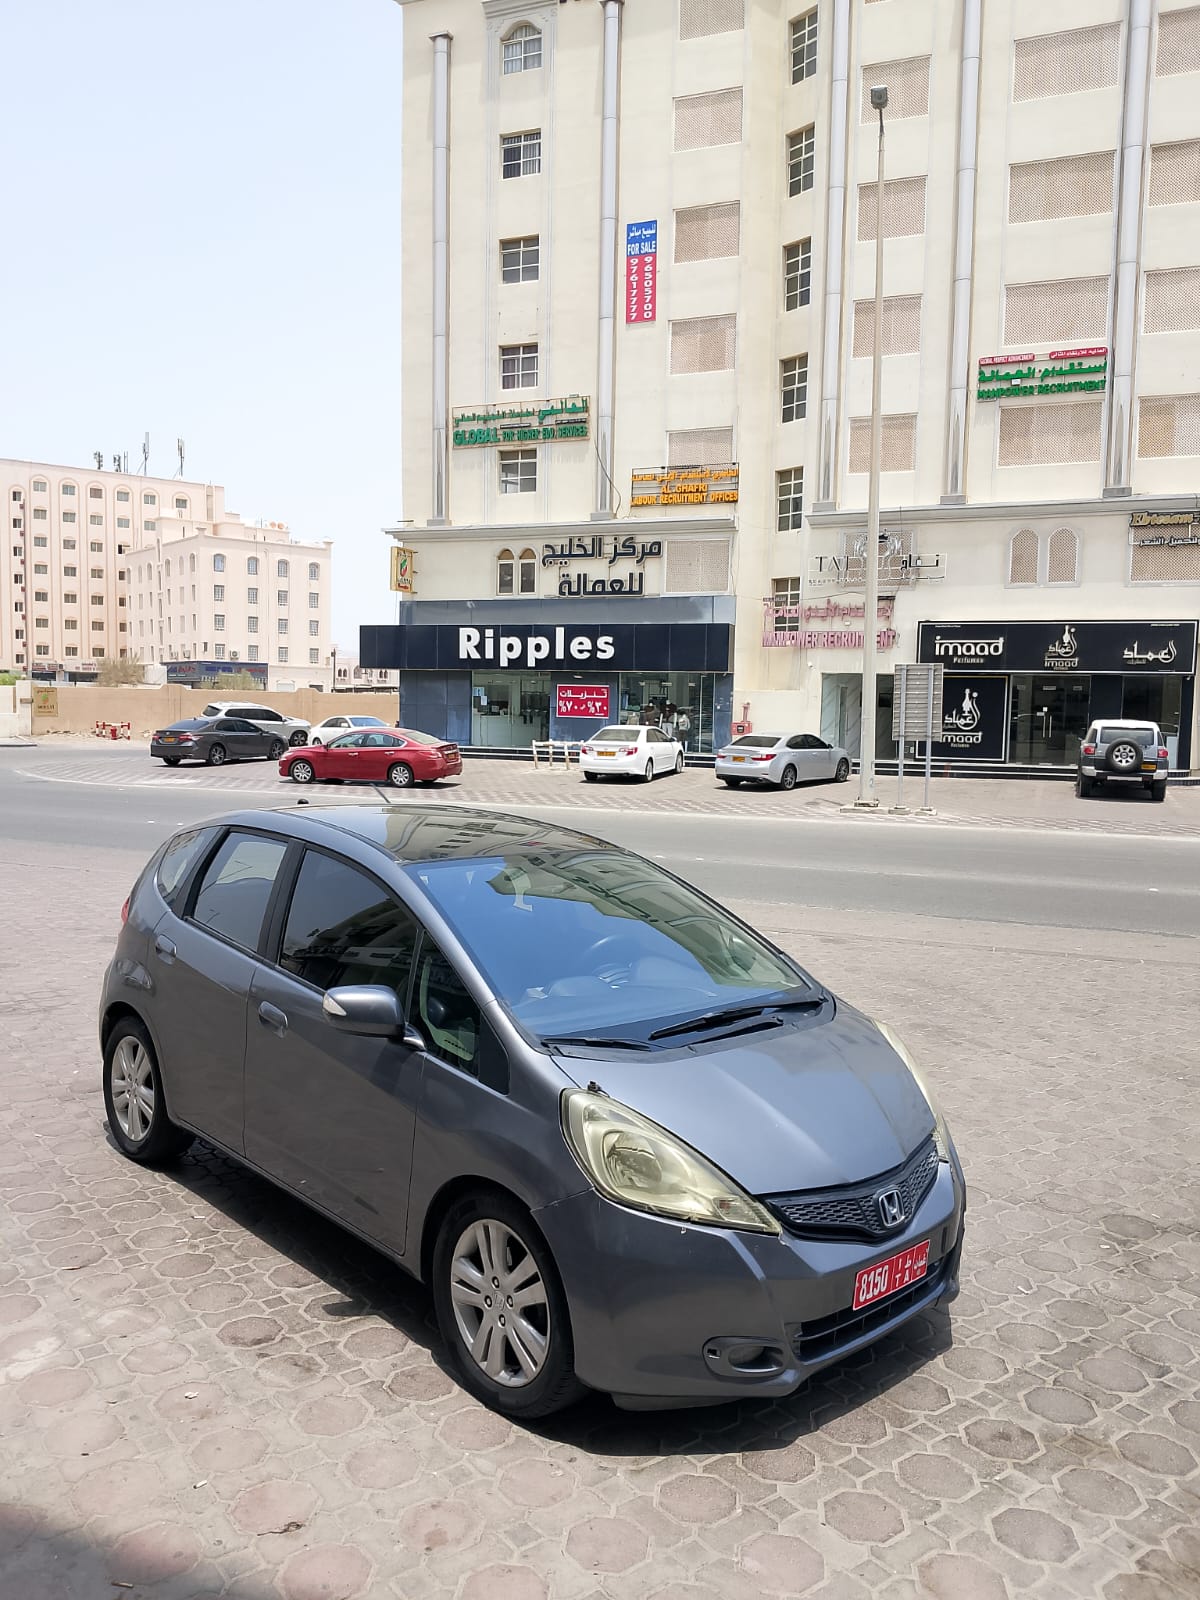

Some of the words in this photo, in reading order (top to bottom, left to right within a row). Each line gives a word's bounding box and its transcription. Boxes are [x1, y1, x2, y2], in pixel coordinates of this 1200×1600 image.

[628, 225, 642, 240] مباشر
[627, 243, 640, 256] FOR
[640, 240, 656, 254] SALE
[629, 258, 639, 320] 97617777
[643, 256, 653, 319] 96505700
[1037, 379, 1106, 395] RECRUITMENT
[453, 427, 500, 446] GLOBAL
[660, 493, 707, 505] RECRUITMENT
[709, 491, 738, 502] OFFICES
[661, 485, 671, 495] AL
[675, 484, 708, 494] GHAFRI
[541, 536, 603, 567] الخليج
[608, 536, 662, 565] مركز
[900, 554, 939, 571] تاج
[558, 571, 645, 596] للعمالة
[459, 627, 615, 667] Ripples
[762, 631, 818, 648] MANPOWER
[822, 630, 897, 649] RECRUITENT
[935, 635, 1004, 656] imaad
[1044, 655, 1079, 668] imaad
[560, 689, 608, 699] تنزيلات
[942, 731, 982, 743] maad
[859, 1264, 890, 1303] 8150
